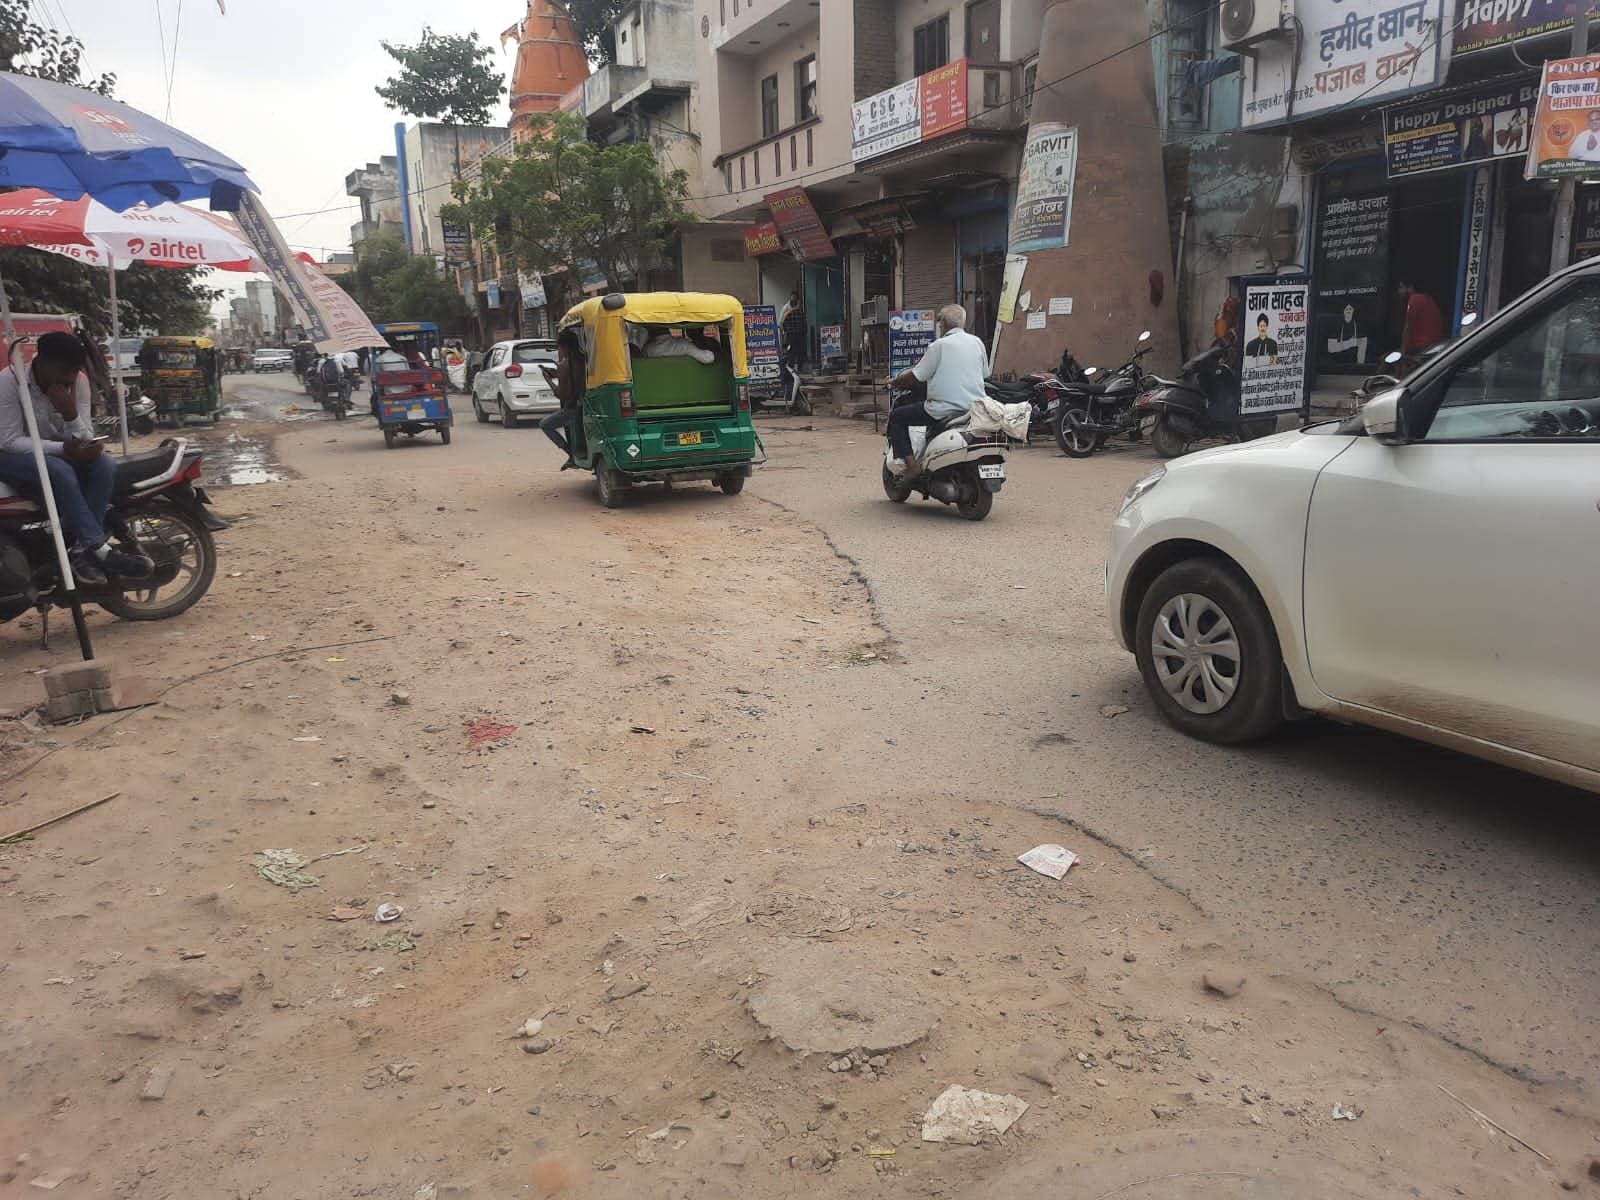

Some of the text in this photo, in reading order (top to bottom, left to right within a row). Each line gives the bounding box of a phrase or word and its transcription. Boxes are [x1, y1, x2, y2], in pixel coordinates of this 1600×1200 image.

[1462, 0, 1532, 31] Happy
[1320, 1, 1428, 63] हमीद खान
[1551, 82, 1566, 95] फिर
[1567, 83, 1581, 94] एक
[869, 94, 896, 120] CSC
[1394, 110, 1440, 131] Happy
[1445, 93, 1513, 119] Designer
[1551, 96, 1583, 109] भाजपा
[1028, 135, 1072, 158] GARVIT
[149, 237, 207, 261] airtel
[1248, 291, 1270, 312] खान
[1271, 290, 1306, 312] साहब
